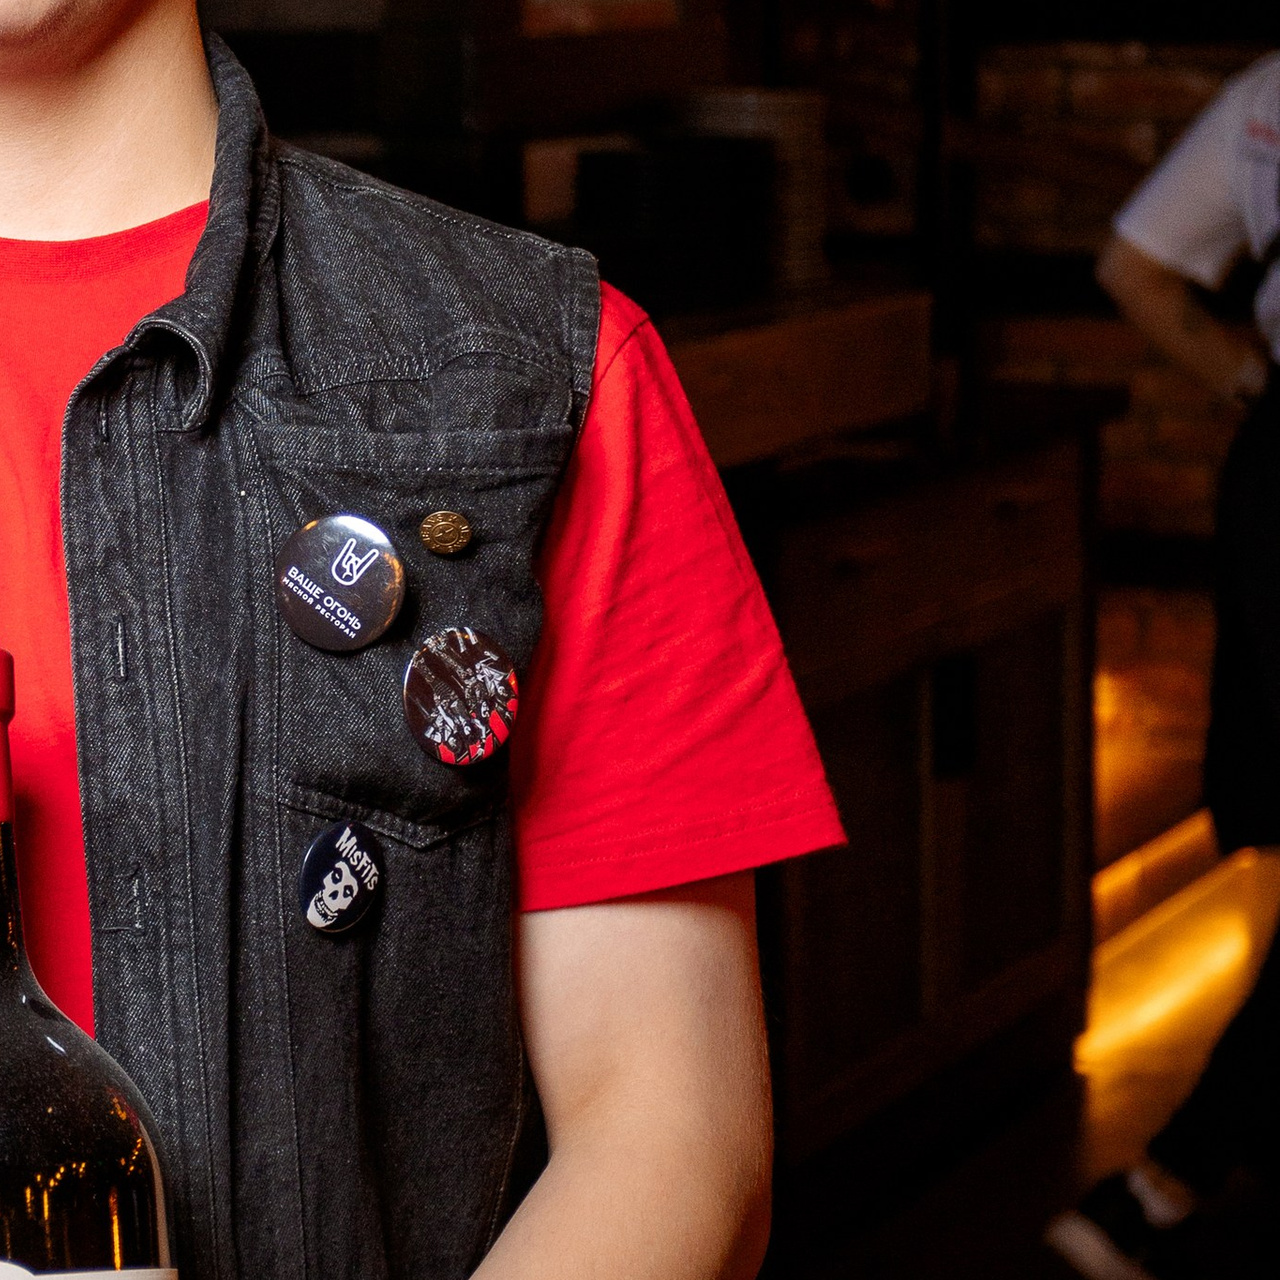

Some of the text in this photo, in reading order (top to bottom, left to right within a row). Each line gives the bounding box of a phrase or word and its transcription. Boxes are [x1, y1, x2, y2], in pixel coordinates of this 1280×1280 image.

[282, 577, 357, 638] МЯСНОЙ РЕСТОРАН
[288, 566, 362, 630] ВАЩЕ ОГОНЬ
